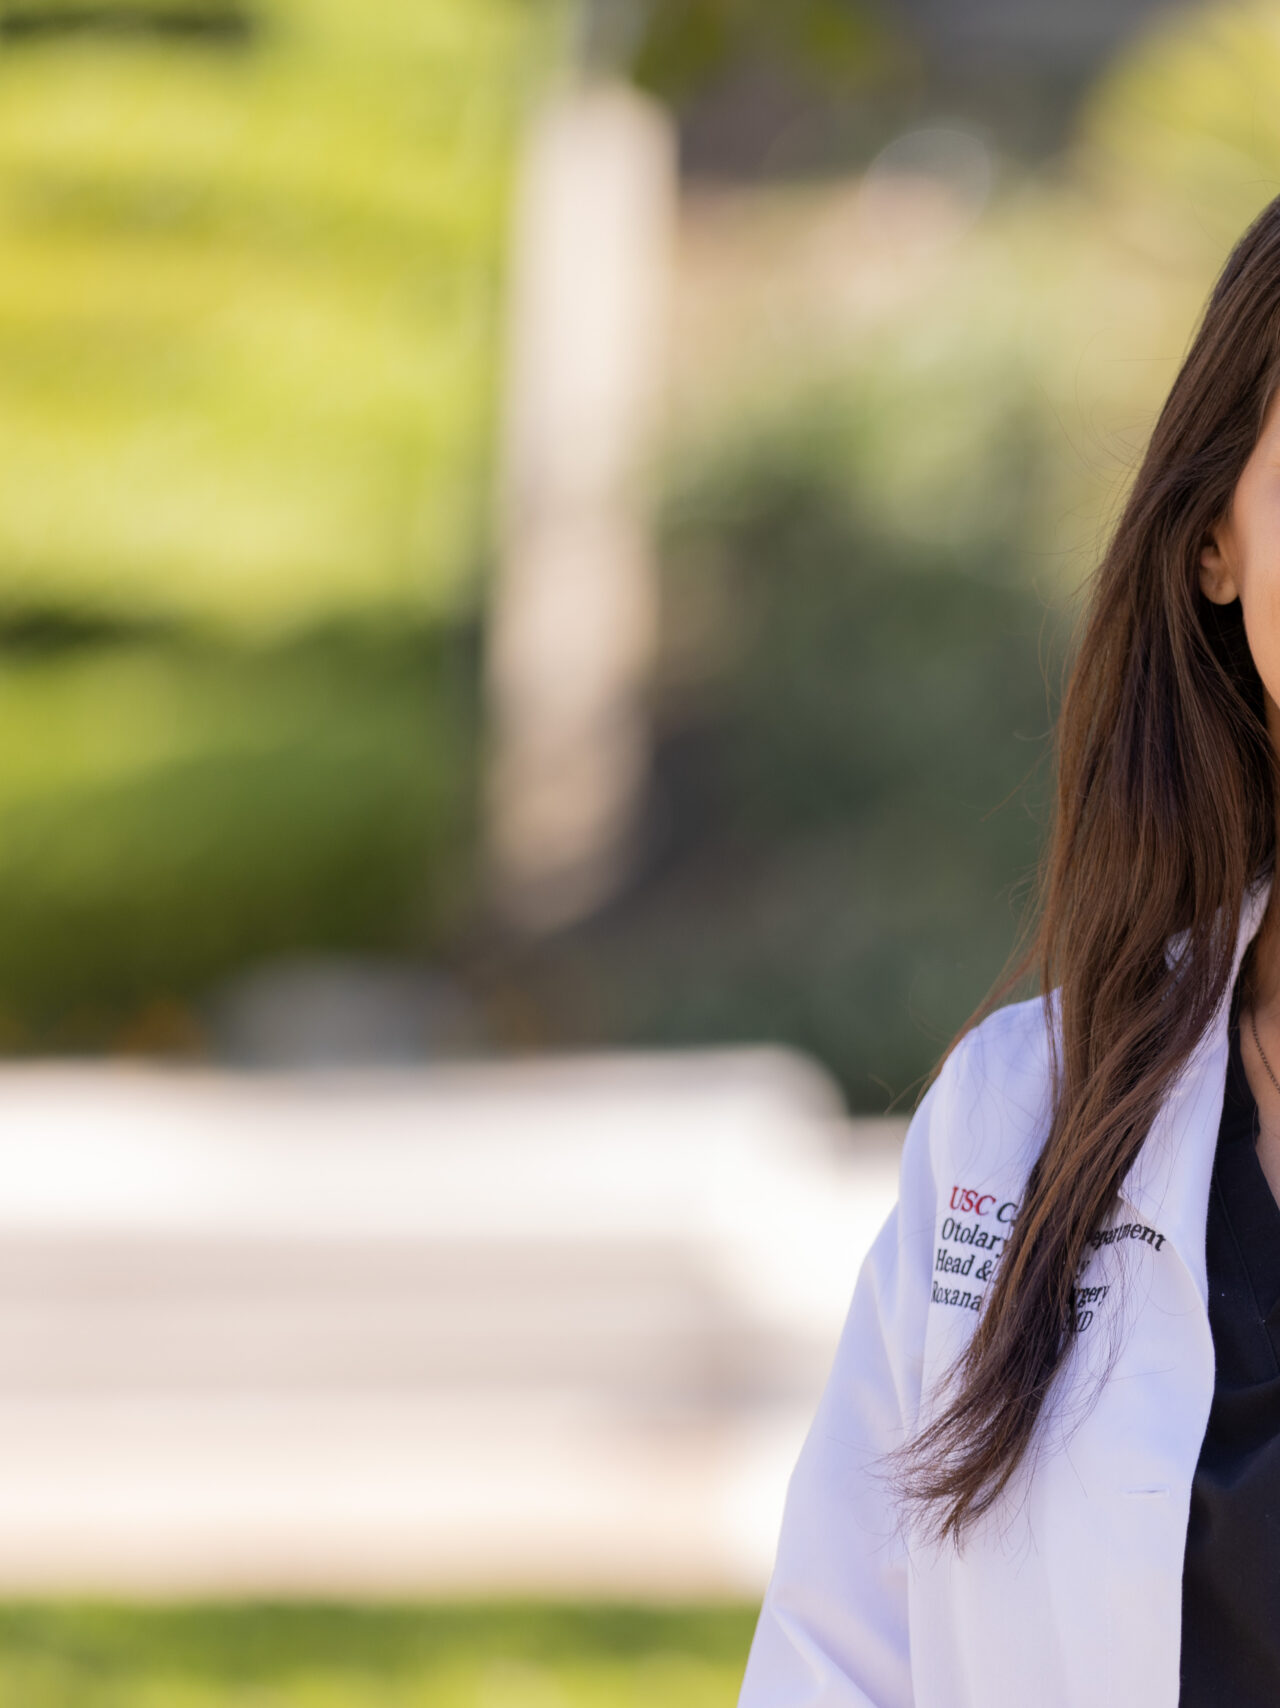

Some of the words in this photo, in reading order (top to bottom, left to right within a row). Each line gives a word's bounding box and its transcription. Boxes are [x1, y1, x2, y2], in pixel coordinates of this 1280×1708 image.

[949, 1185, 996, 1216] USC
[935, 1248, 976, 1276] Head
[975, 1259, 993, 1282] &
